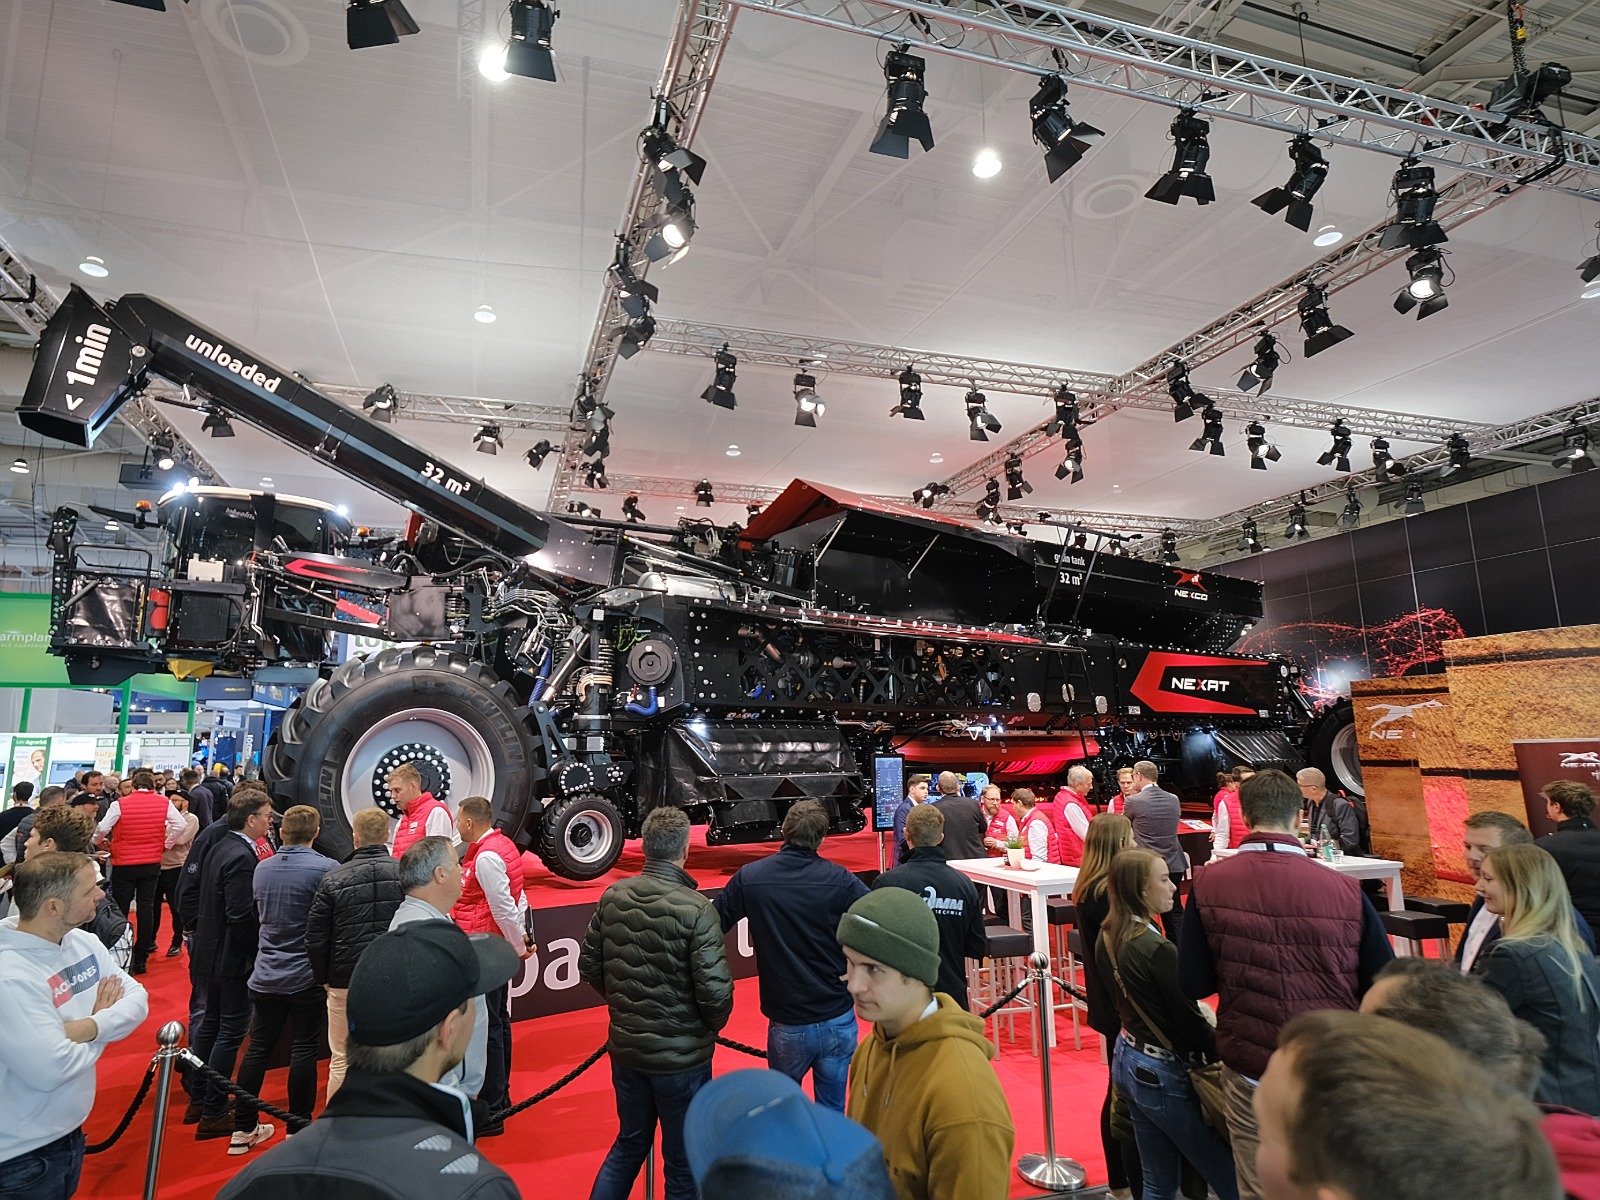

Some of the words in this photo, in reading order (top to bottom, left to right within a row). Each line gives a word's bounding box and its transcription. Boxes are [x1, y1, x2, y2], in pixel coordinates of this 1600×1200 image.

[65, 323, 111, 386] 1min
[185, 334, 281, 394] unloaded
[420, 461, 445, 484] 32
[1071, 556, 1086, 566] tank
[1059, 571, 1071, 584] 32
[1174, 589, 1209, 602] NEXCO
[1171, 677, 1230, 692] NEXAT
